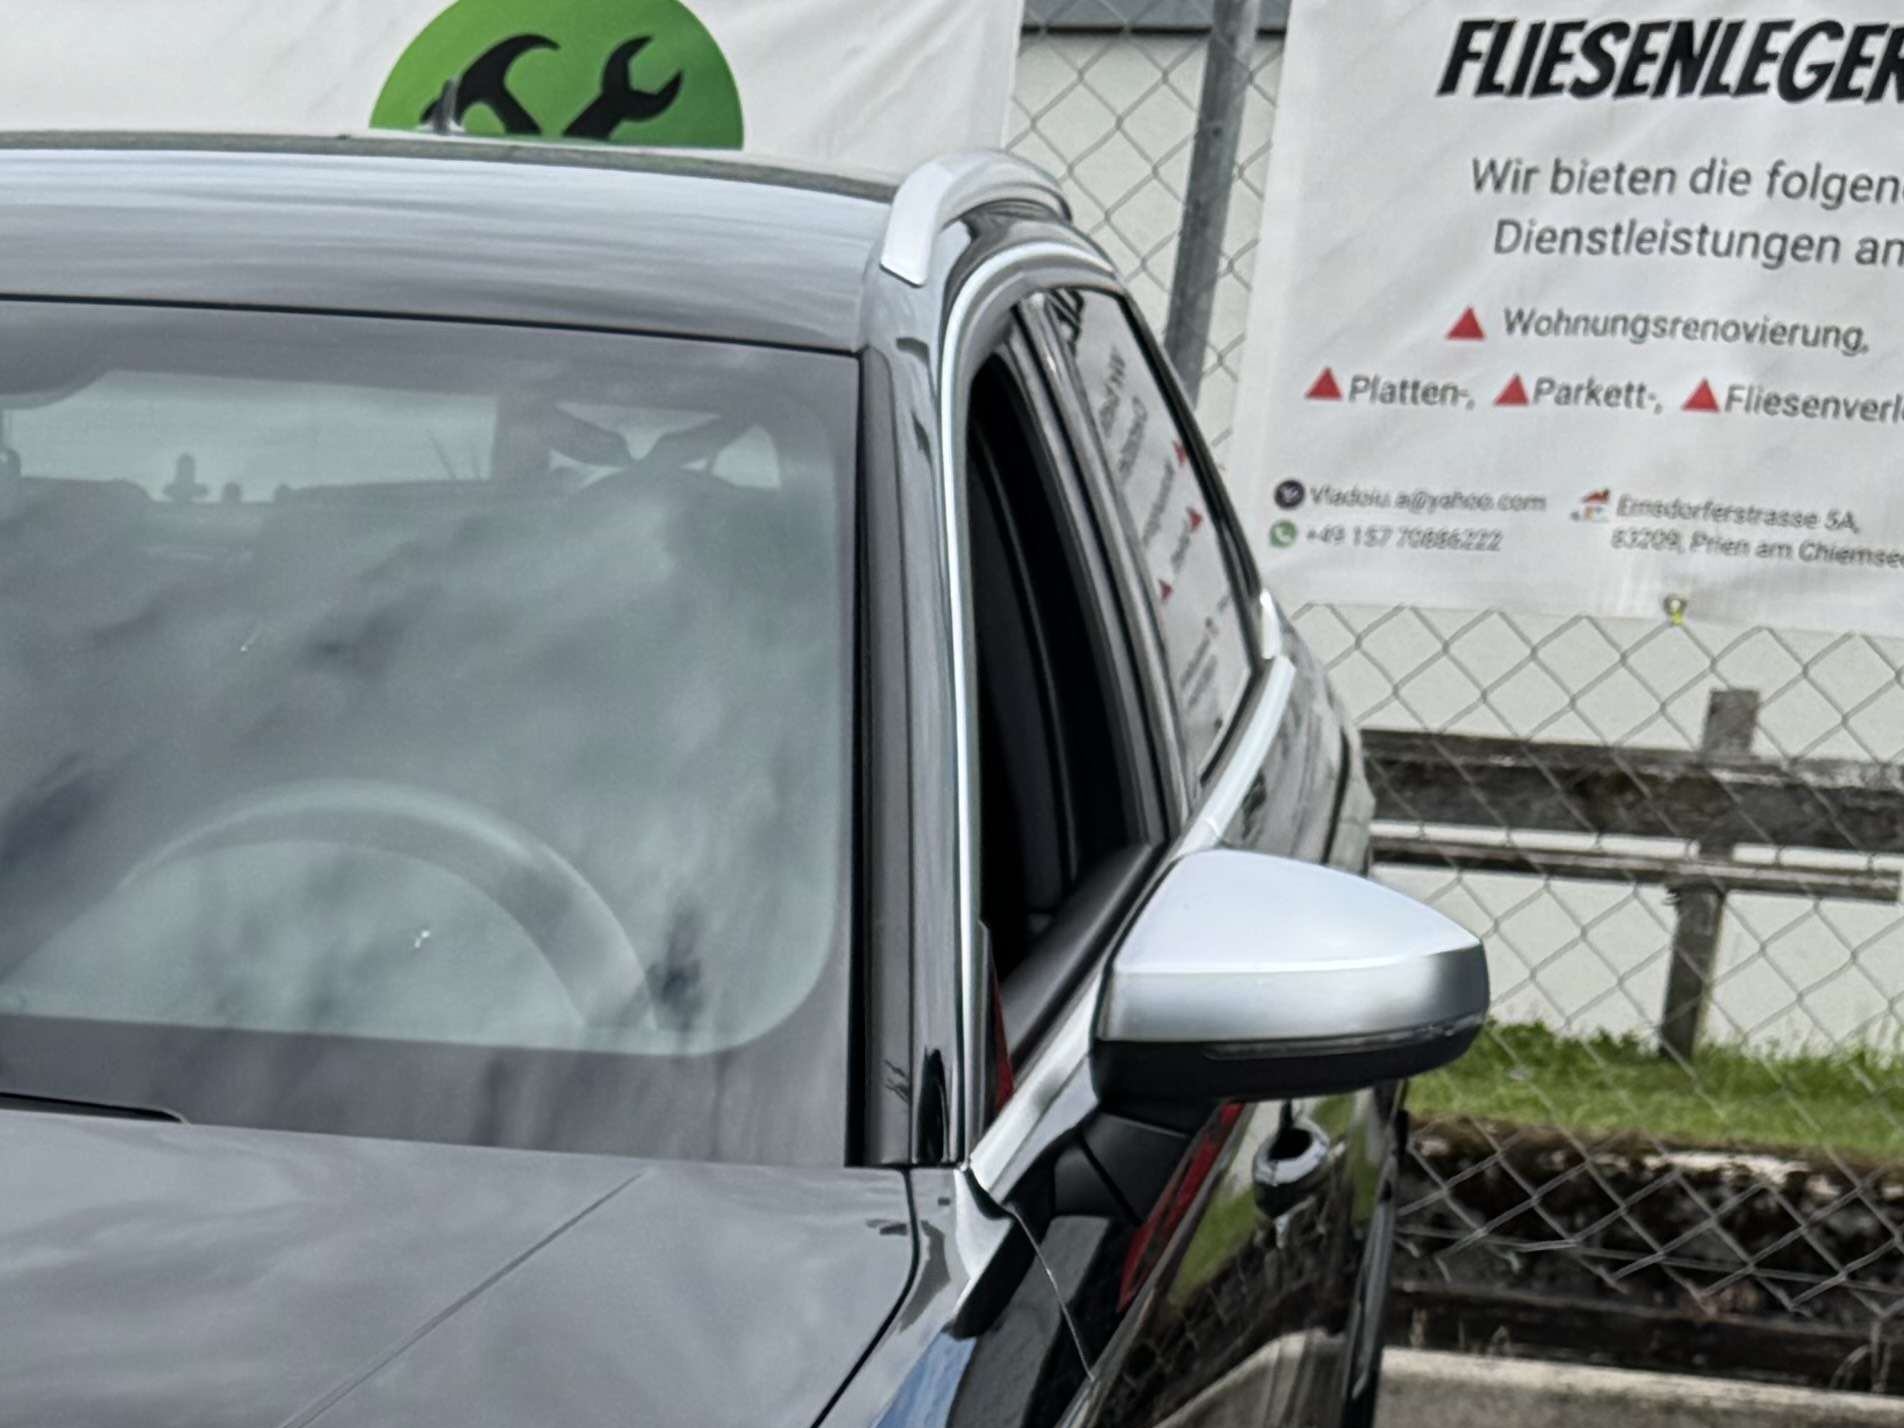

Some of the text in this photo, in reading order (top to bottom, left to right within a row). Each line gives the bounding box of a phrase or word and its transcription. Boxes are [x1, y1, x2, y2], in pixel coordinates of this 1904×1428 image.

[1470, 156, 1540, 195] Wir
[1550, 156, 1677, 197] bieten
[1690, 157, 1752, 197] die
[1492, 218, 1840, 270] Dienstleistungen
[1724, 383, 1904, 426] Fliesenverl
[1755, 541, 1792, 559] am
